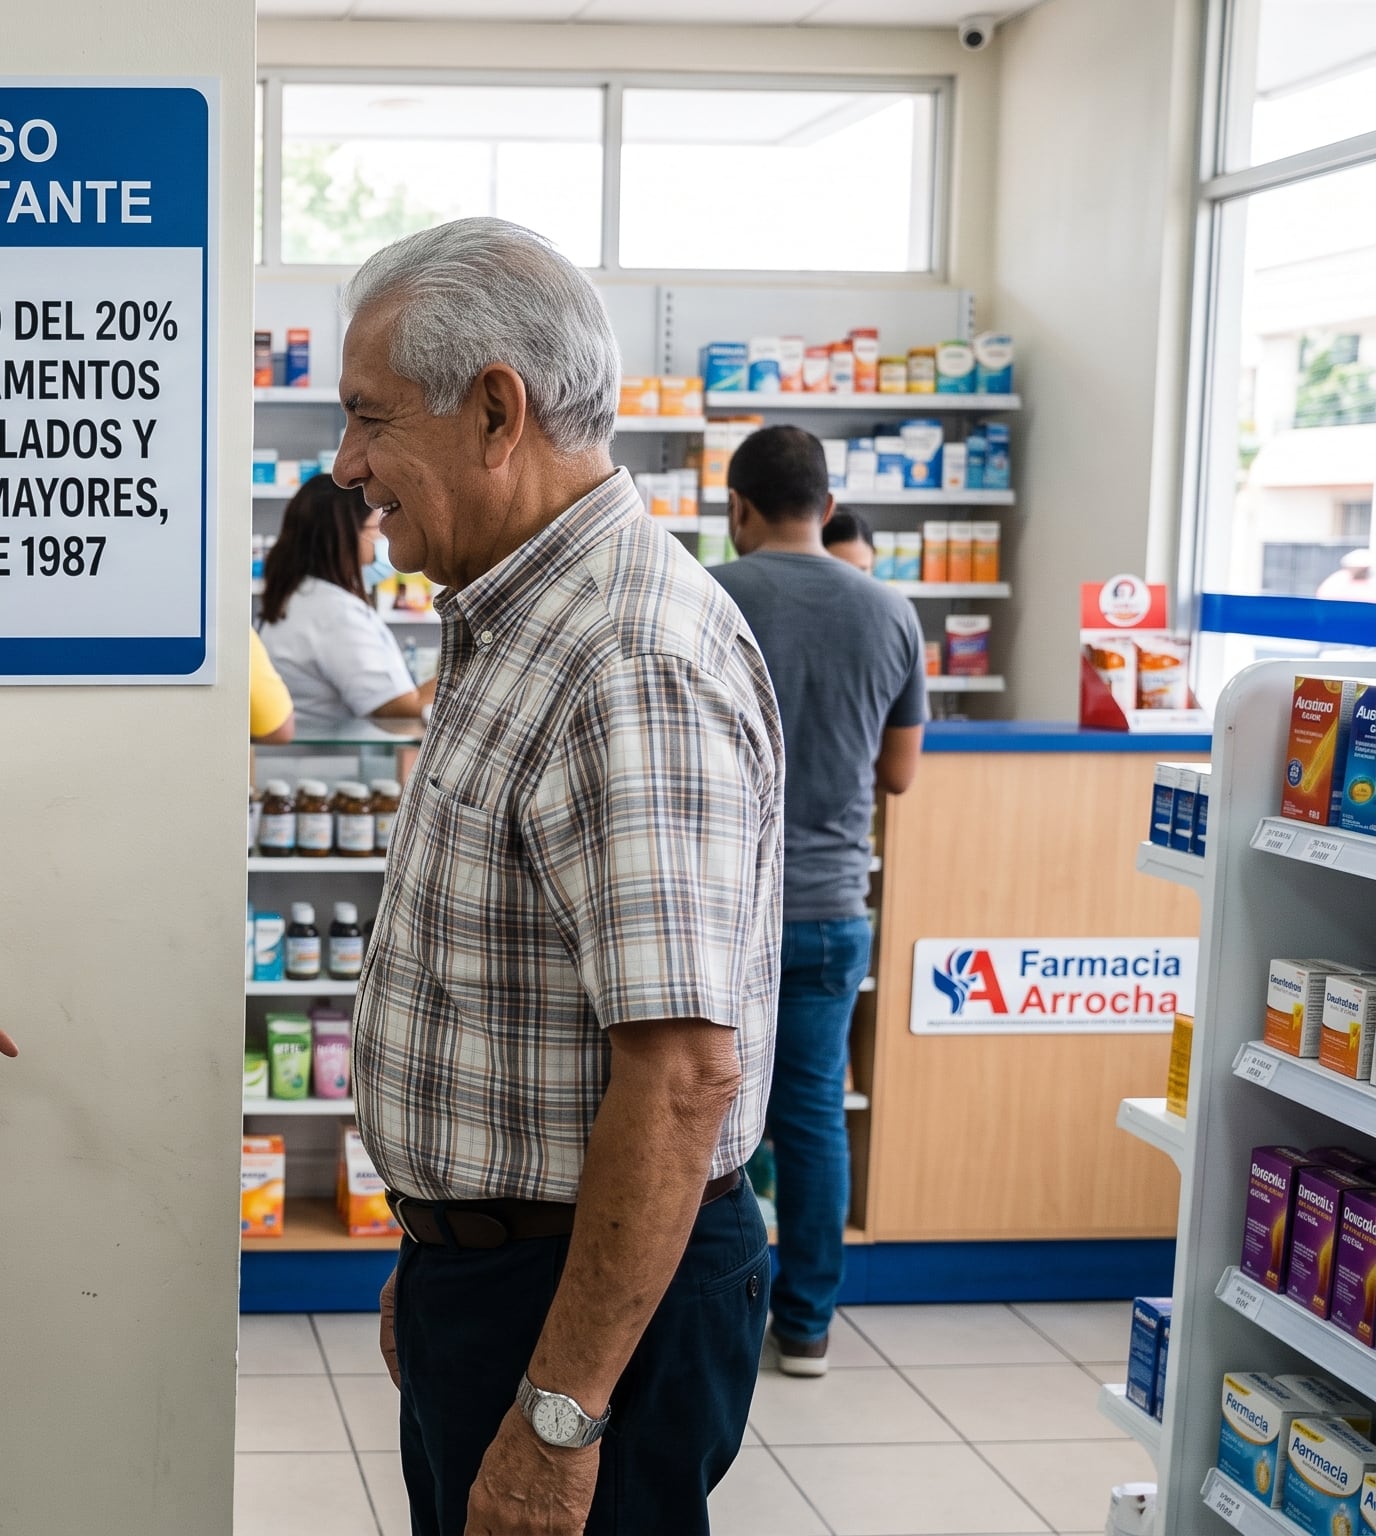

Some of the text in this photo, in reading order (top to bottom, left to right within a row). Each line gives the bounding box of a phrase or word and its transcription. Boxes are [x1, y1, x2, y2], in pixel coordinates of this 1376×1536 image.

[14, 300, 85, 341] DEL
[95, 300, 178, 342] 20%
[132, 419, 157, 459] Y
[21, 535, 107, 577] 1987
[1020, 949, 1181, 977] Farmacia
[1019, 984, 1179, 1015] Arrocha
